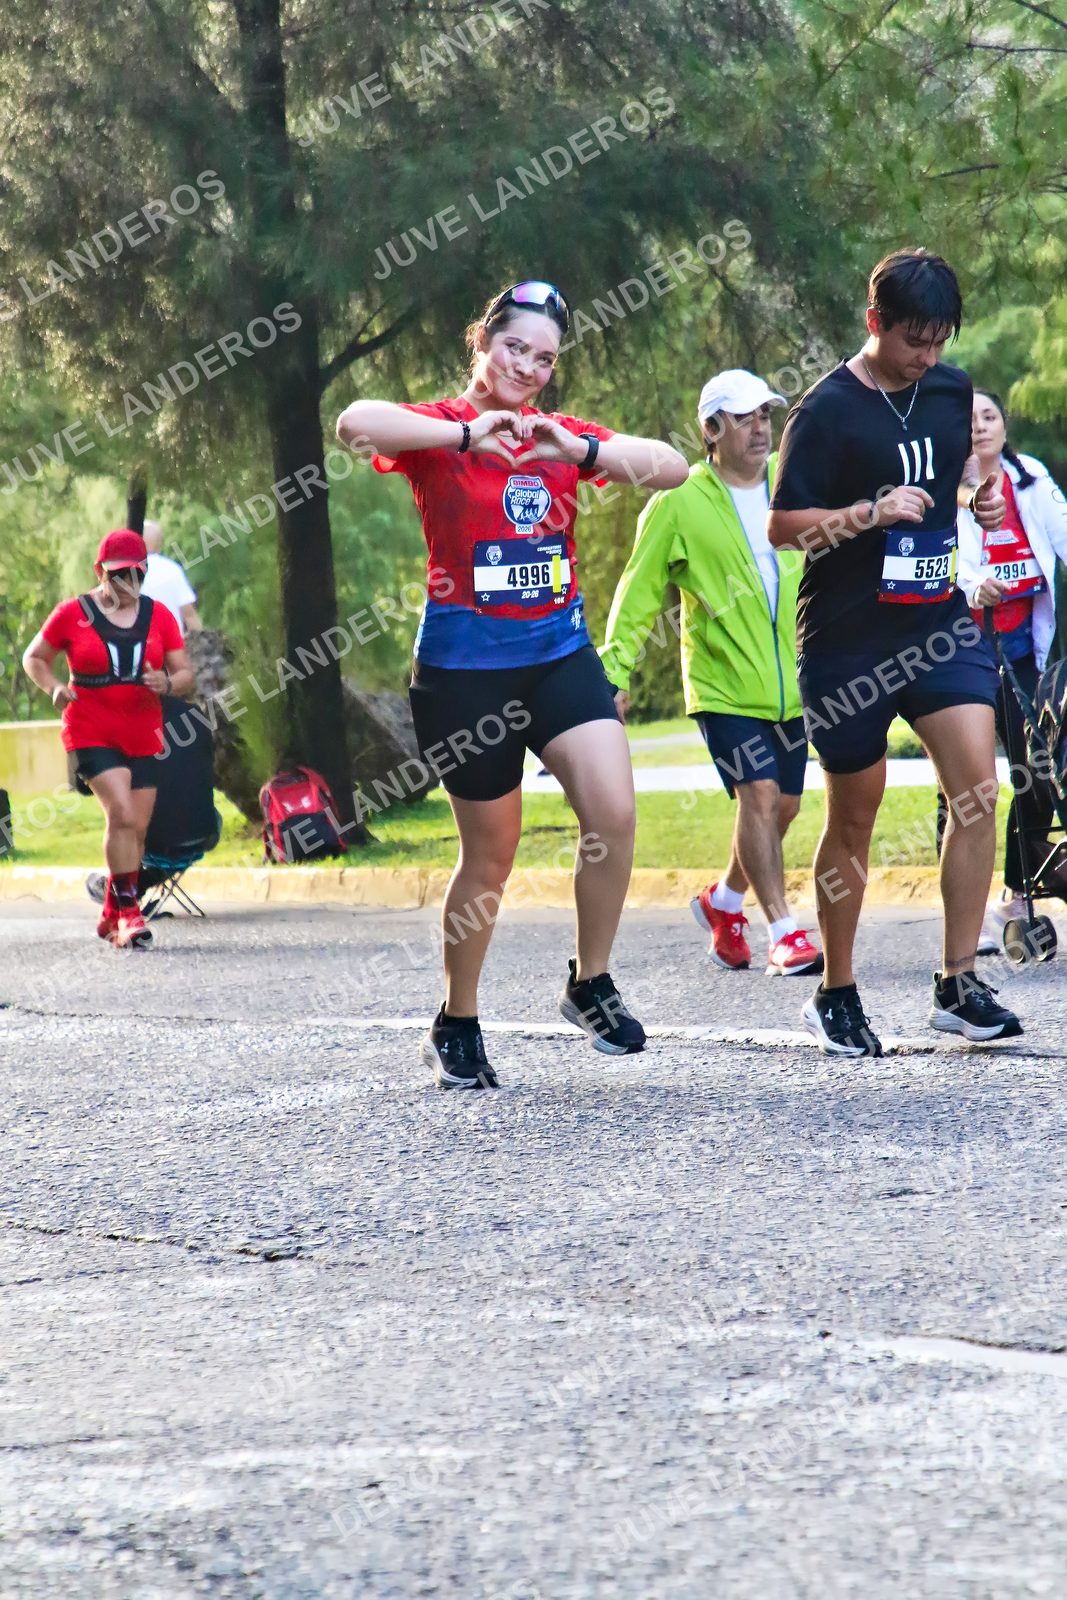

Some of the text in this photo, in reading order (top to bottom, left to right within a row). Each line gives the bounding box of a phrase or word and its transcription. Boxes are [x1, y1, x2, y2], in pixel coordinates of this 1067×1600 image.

[515, 489, 540, 499] Global
[510, 496, 531, 505] Race
[517, 525, 532, 533] 2026
[914, 556, 949, 579] 5523
[994, 562, 1027, 581] 2994
[507, 563, 550, 588] 4996
[521, 589, 540, 599] 20-26
